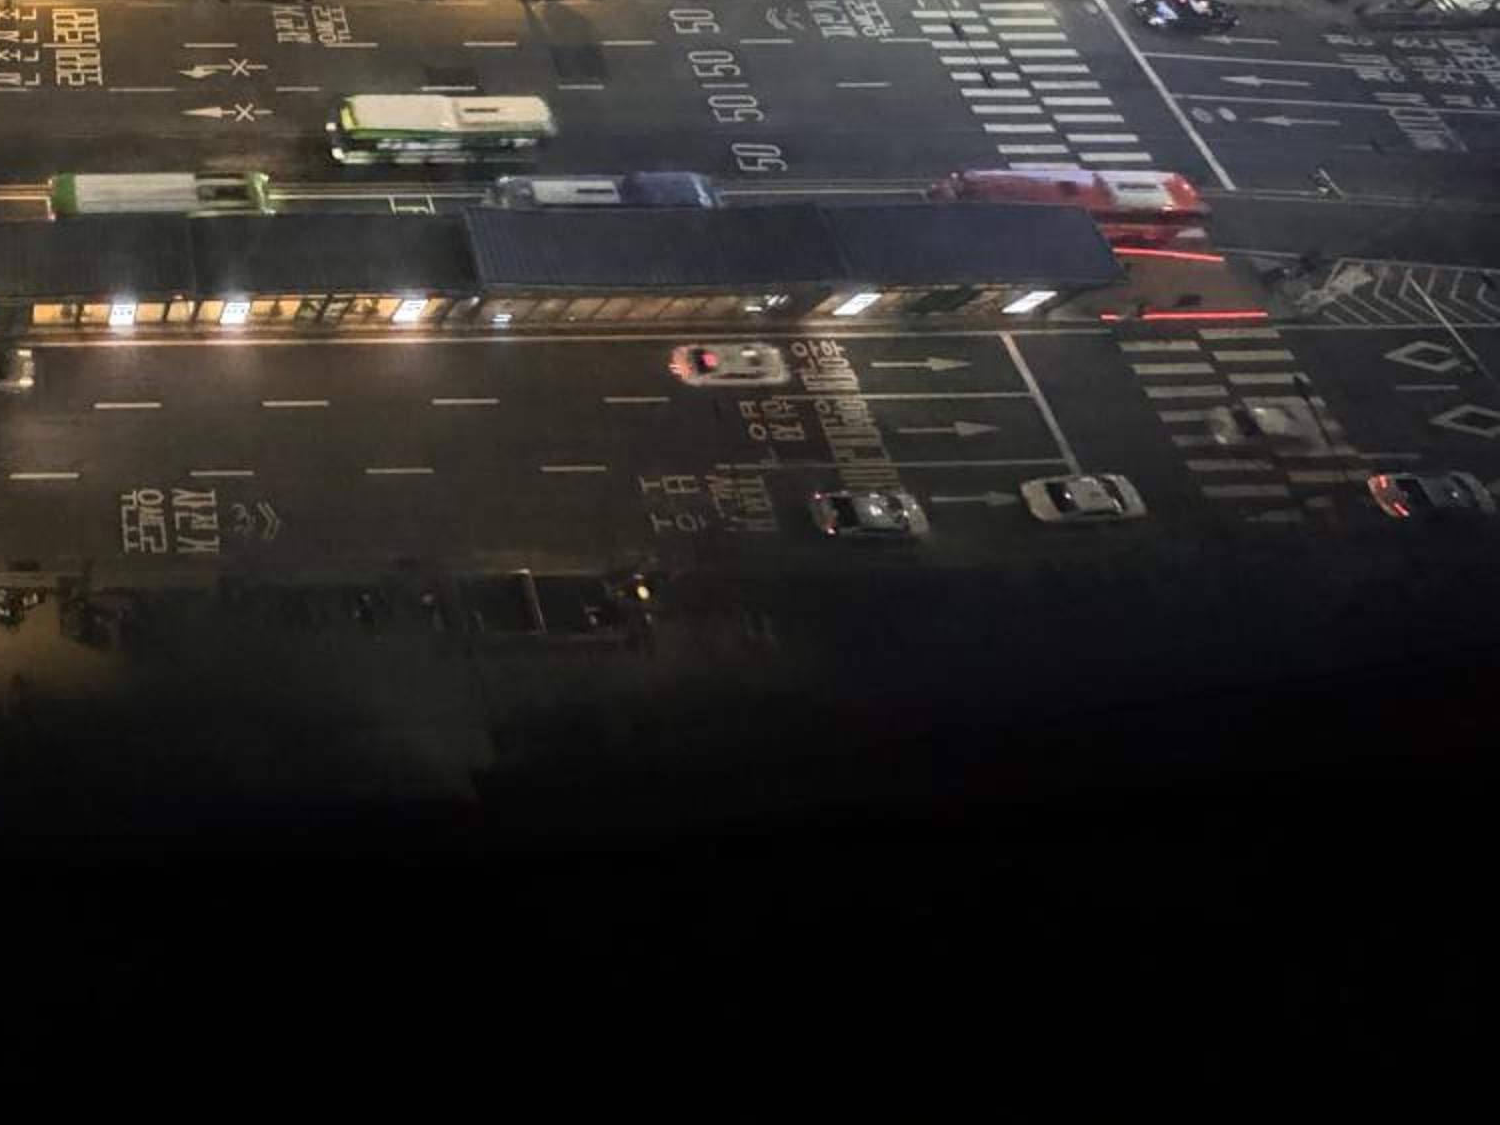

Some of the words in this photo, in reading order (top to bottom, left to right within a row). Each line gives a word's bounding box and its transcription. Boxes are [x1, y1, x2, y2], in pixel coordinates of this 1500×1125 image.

[669, 8, 720, 35] 50
[688, 50, 741, 78] 50
[708, 95, 765, 123] 50
[732, 143, 788, 173] 50
[170, 488, 221, 555] 자전거
